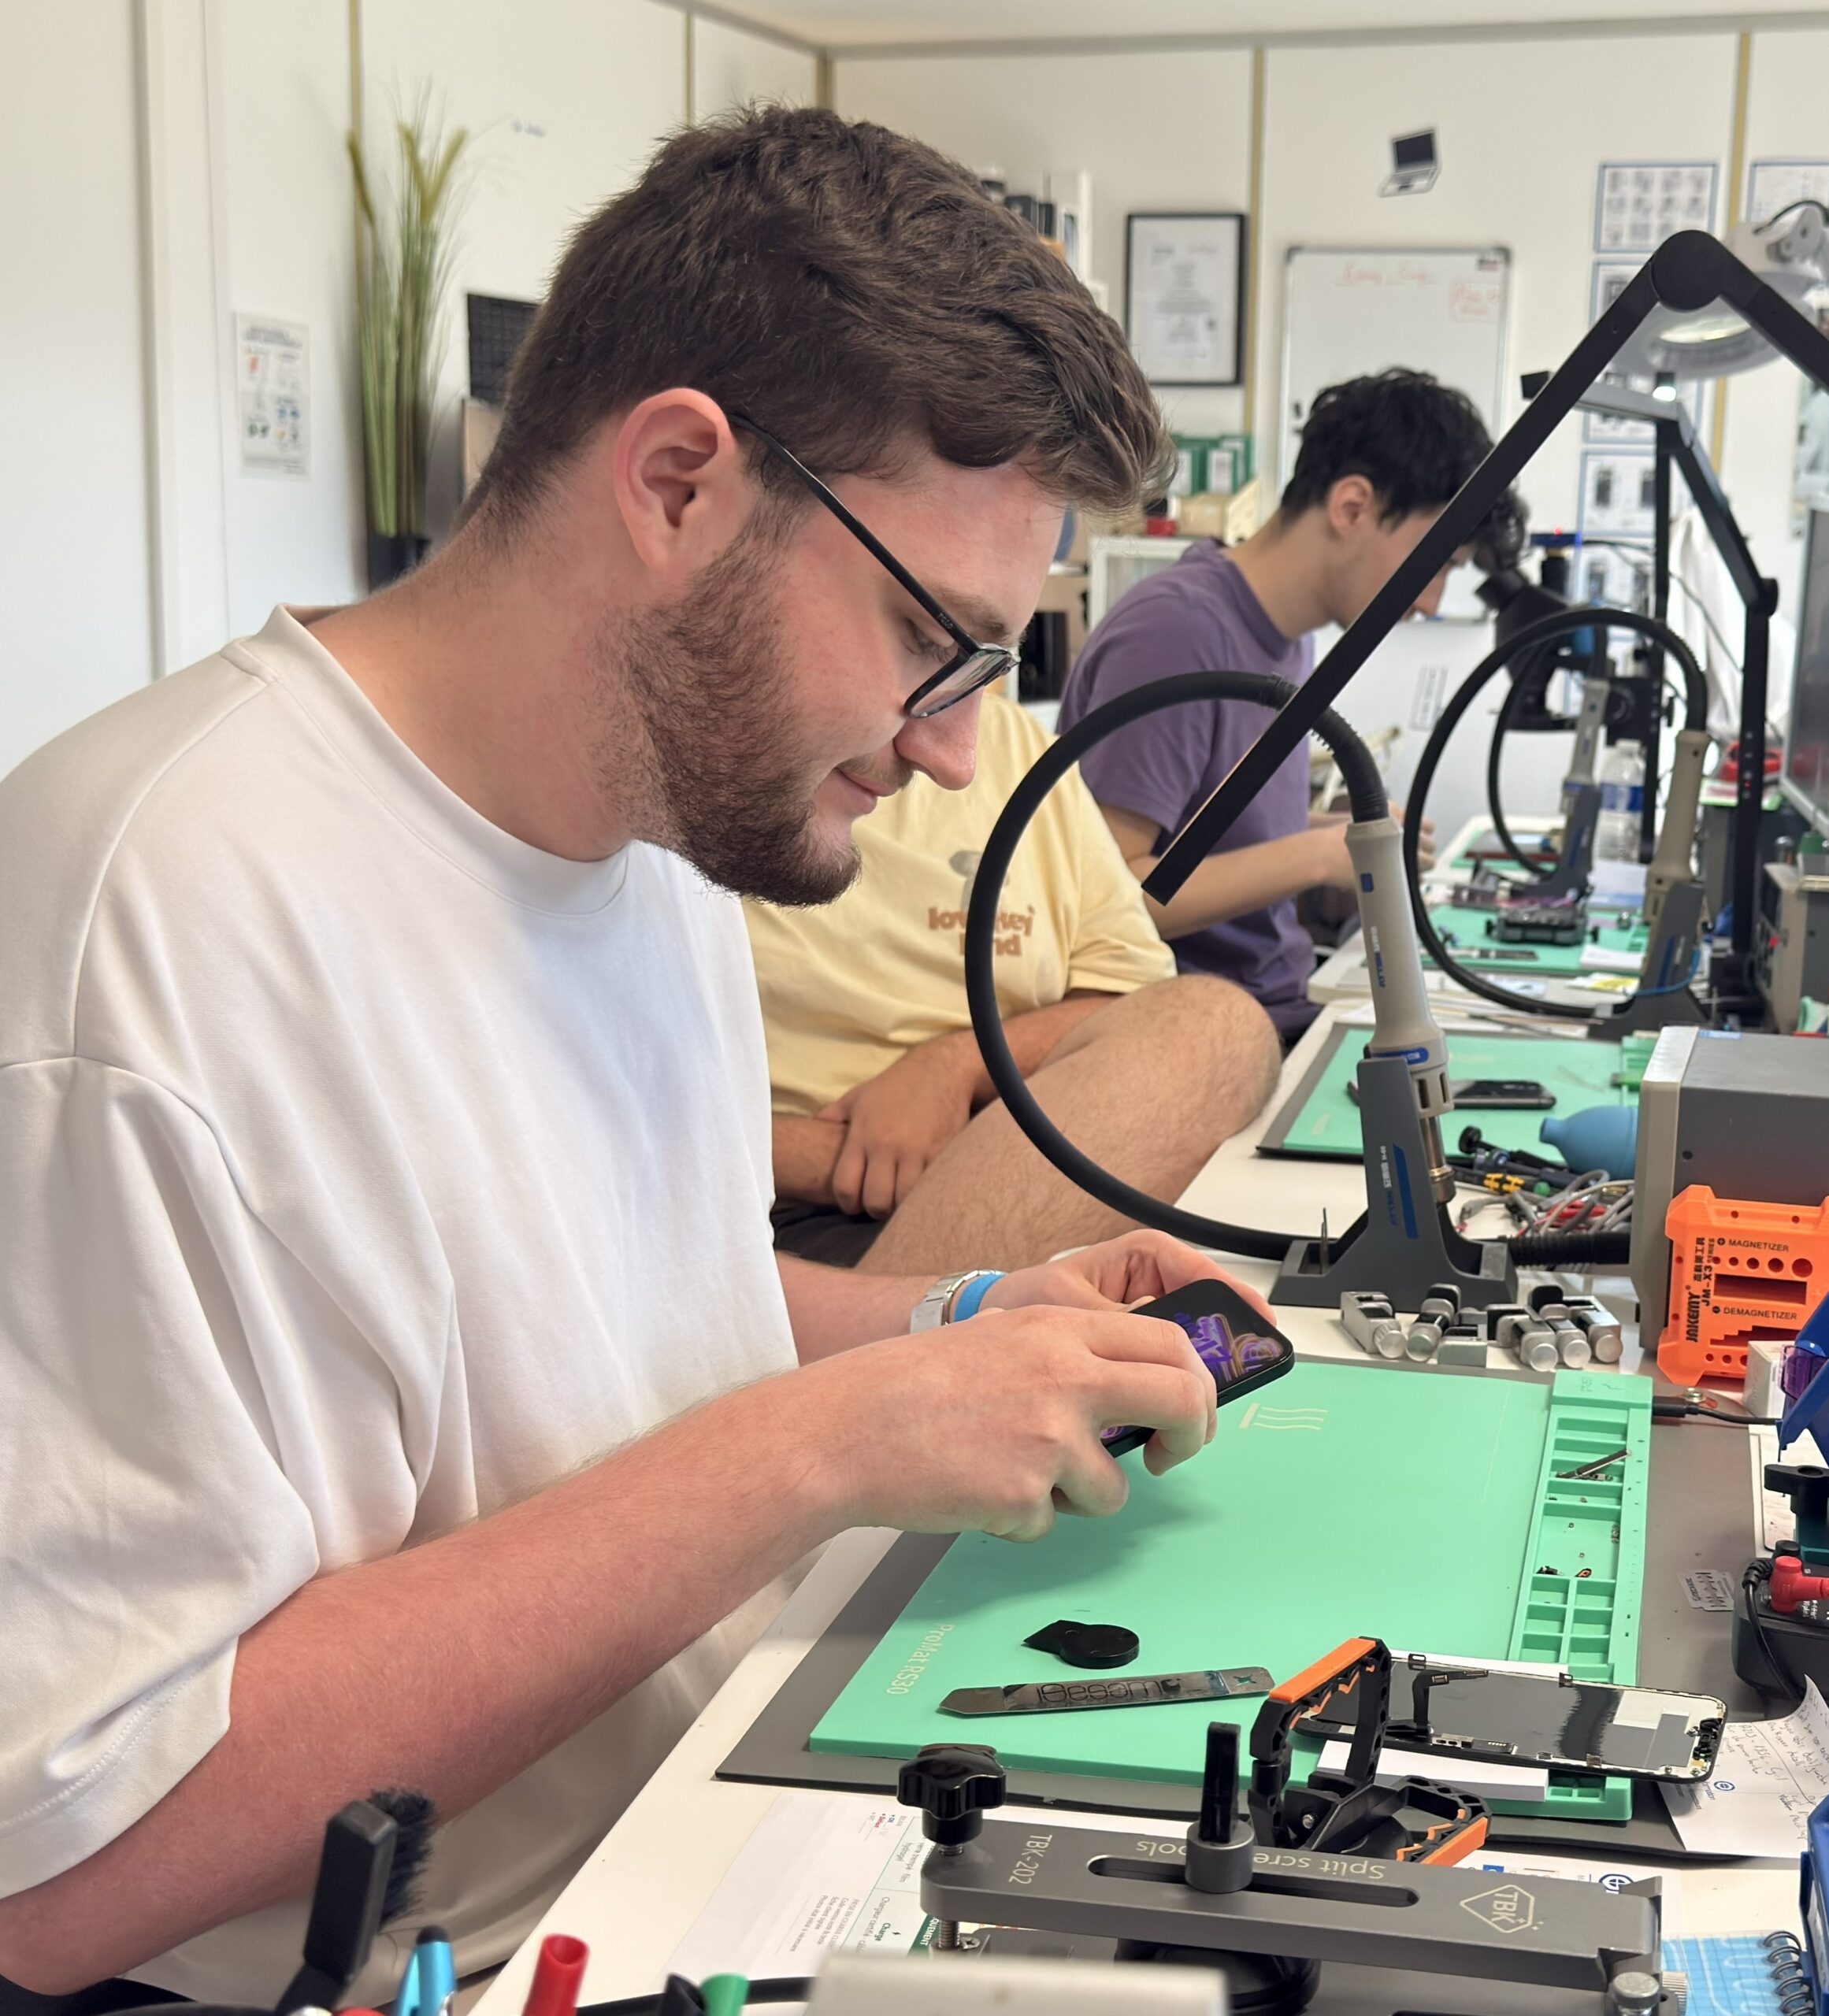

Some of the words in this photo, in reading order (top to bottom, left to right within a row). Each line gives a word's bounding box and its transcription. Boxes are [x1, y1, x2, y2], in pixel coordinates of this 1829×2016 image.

[1729, 1238, 1790, 1252] MAGNETIZER
[1686, 1290, 1701, 1343] JAKEMY
[1723, 1306, 1797, 1321] DEMAGNETIZER
[908, 1624, 955, 1663] ProMat
[886, 1666, 926, 1695] RS30
[1008, 1834, 1053, 1884] TBK-202
[1253, 1852, 1311, 1868] scre
[1319, 1859, 1386, 1880] Split
[1490, 1892, 1519, 1925] TBK
[874, 1922, 891, 1941] Charge
[920, 1917, 939, 1946] QUEMENT
